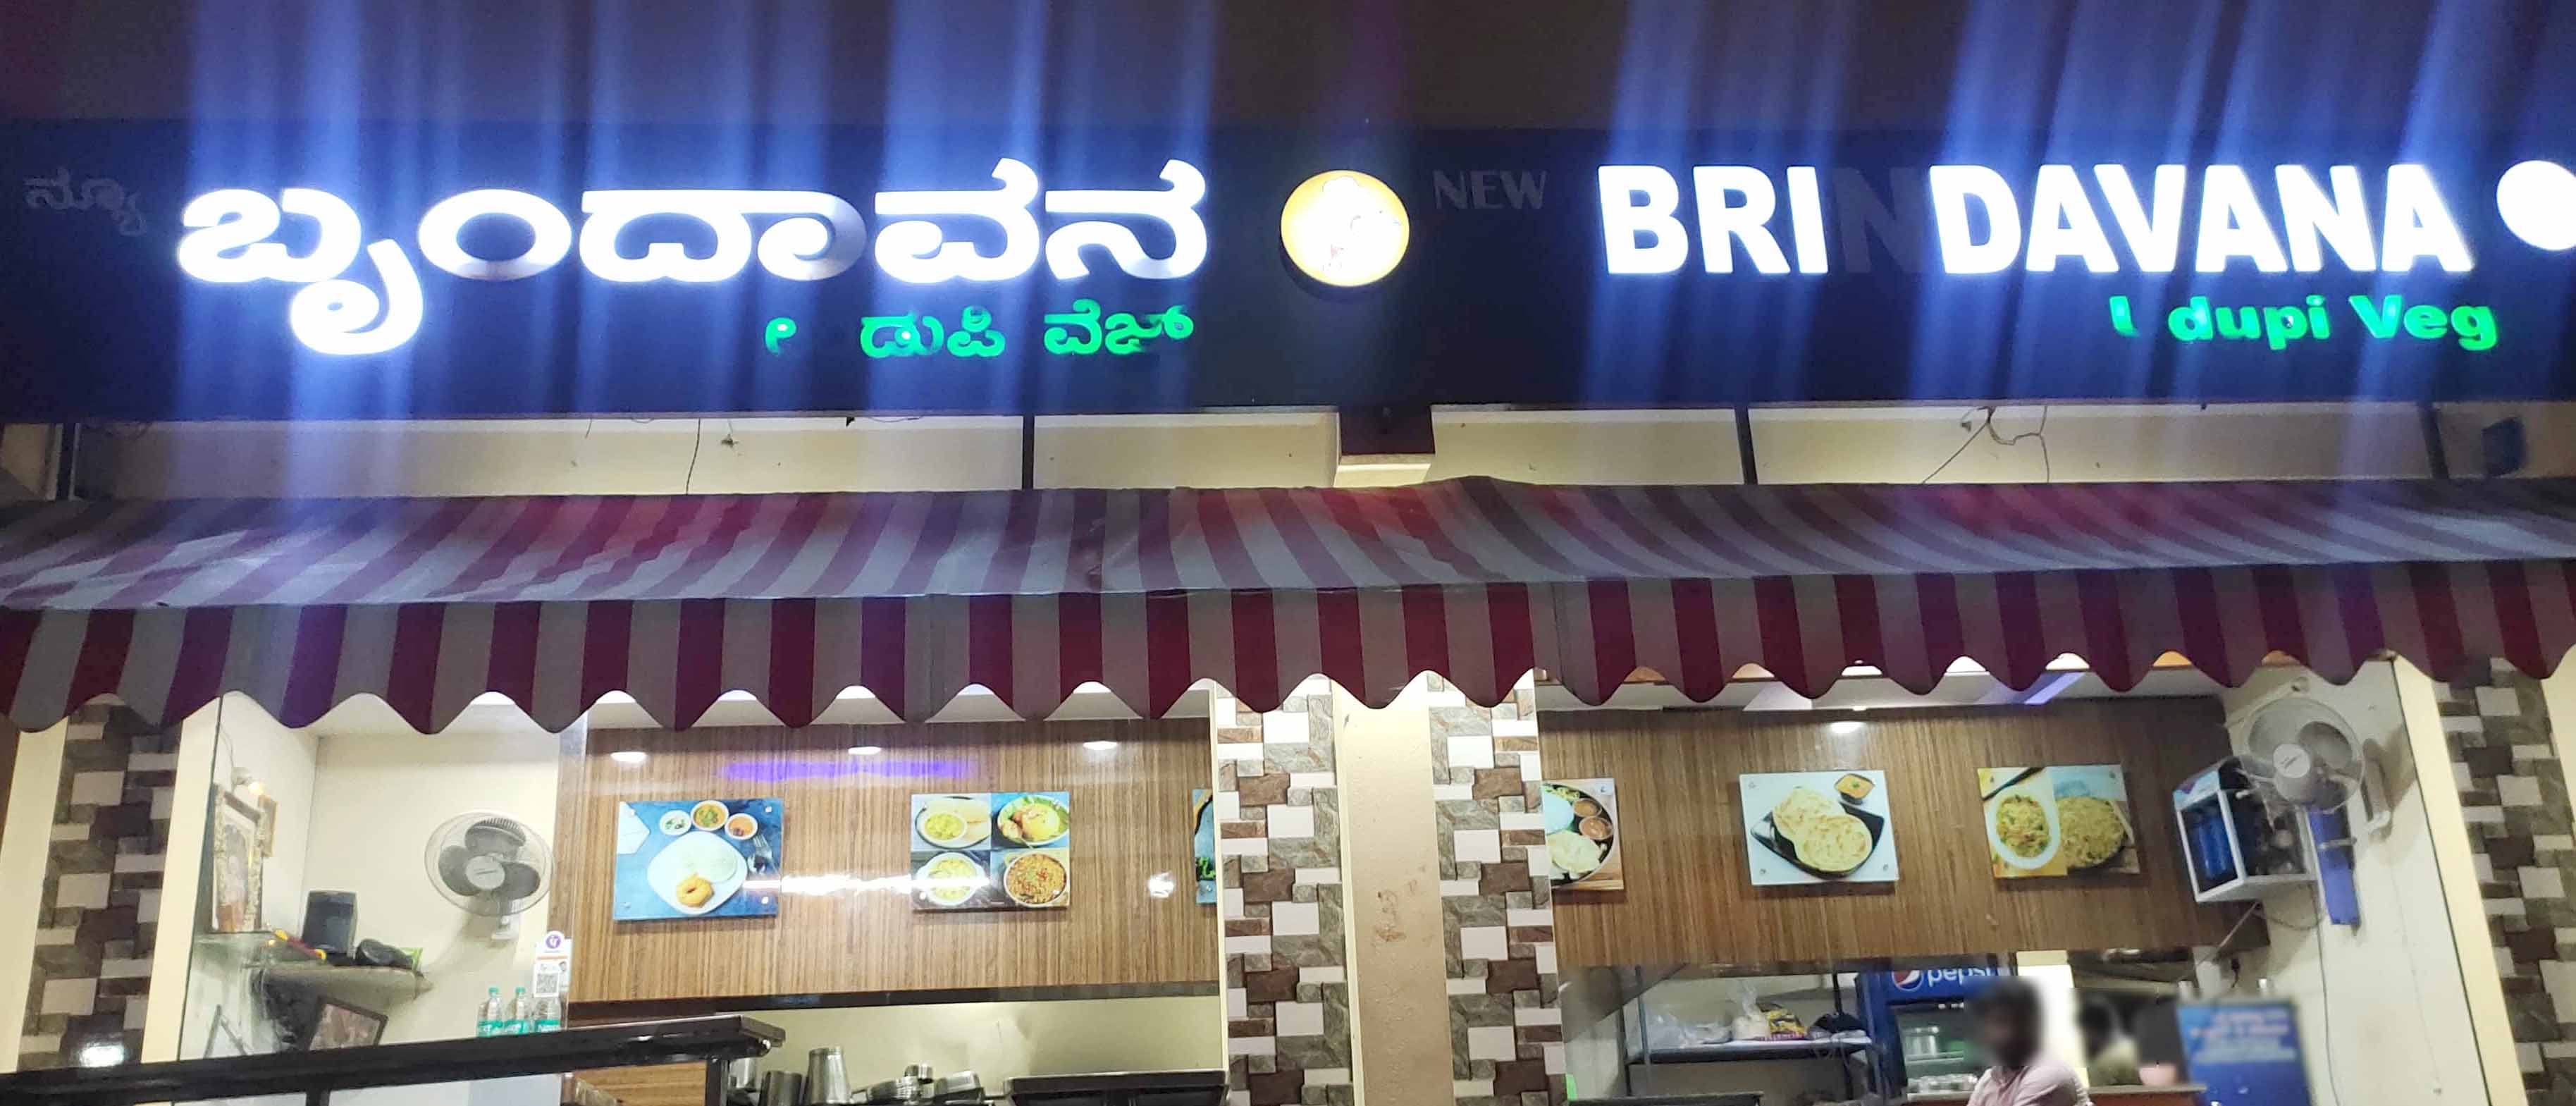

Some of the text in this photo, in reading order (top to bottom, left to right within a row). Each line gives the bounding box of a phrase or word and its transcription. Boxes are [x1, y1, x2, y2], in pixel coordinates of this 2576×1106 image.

[1433, 170, 1547, 209] NEW
[178, 158, 1207, 355] ಬೃಂದಾವನ
[2349, 295, 2498, 351] Veg
